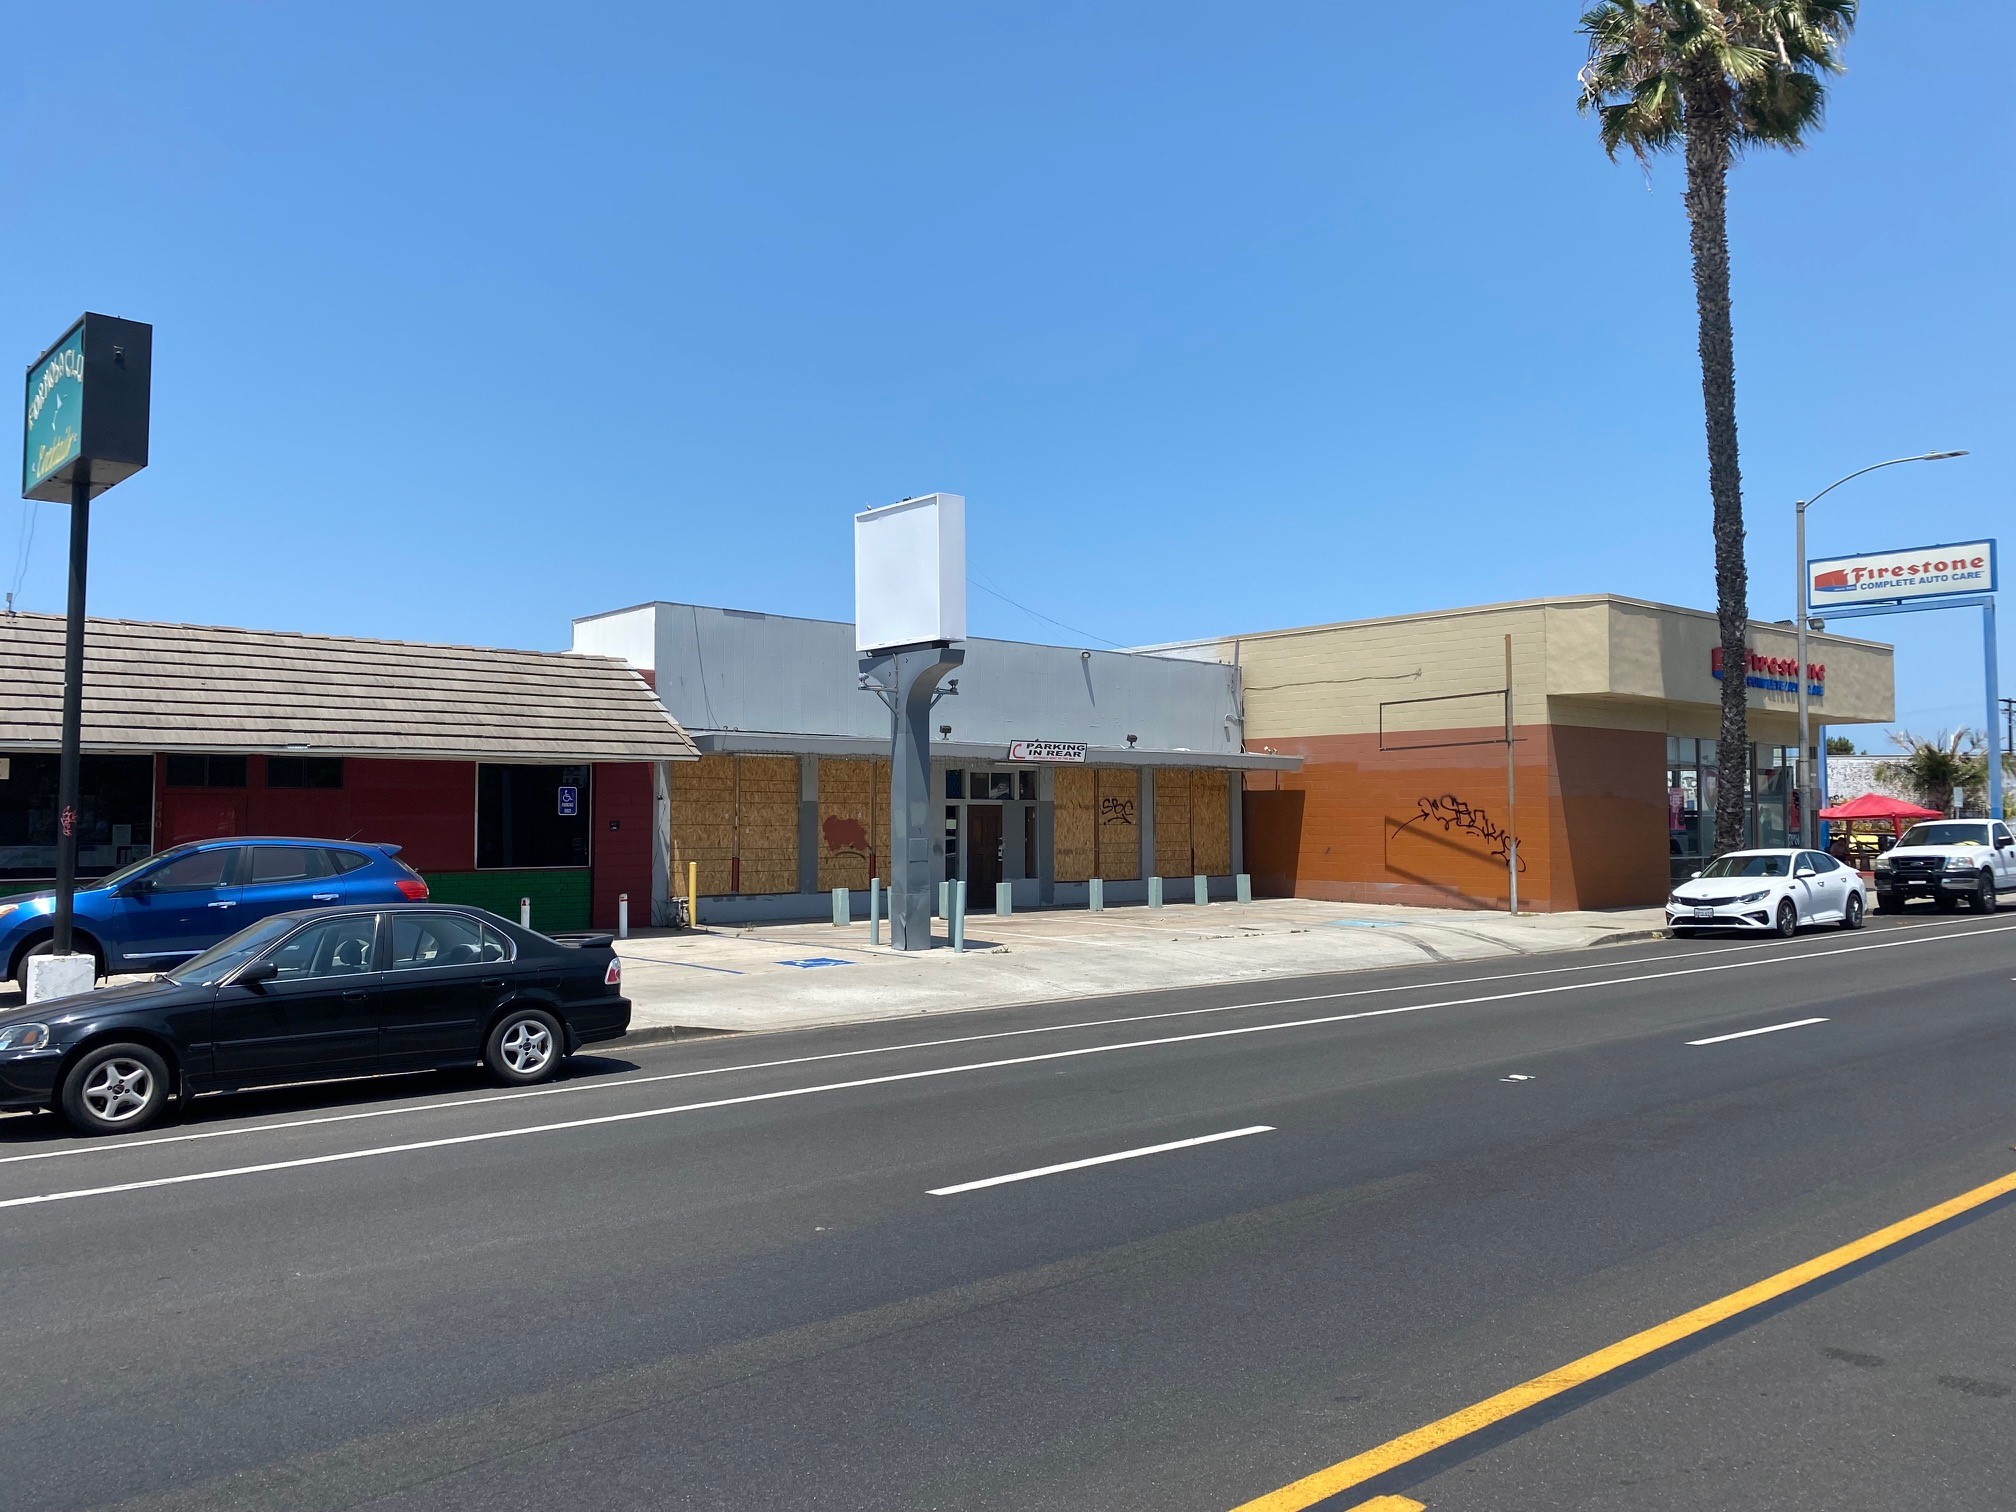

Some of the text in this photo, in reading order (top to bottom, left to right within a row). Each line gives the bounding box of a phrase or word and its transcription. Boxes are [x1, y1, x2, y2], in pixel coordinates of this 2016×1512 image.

[1851, 556, 1985, 584] Firestone
[1860, 578, 1916, 590] COMPLETE
[1918, 574, 1948, 585] AUTO
[1743, 648, 1826, 681] Firestne
[1026, 743, 1086, 751] PARKING
[1046, 750, 1082, 758] REAR
